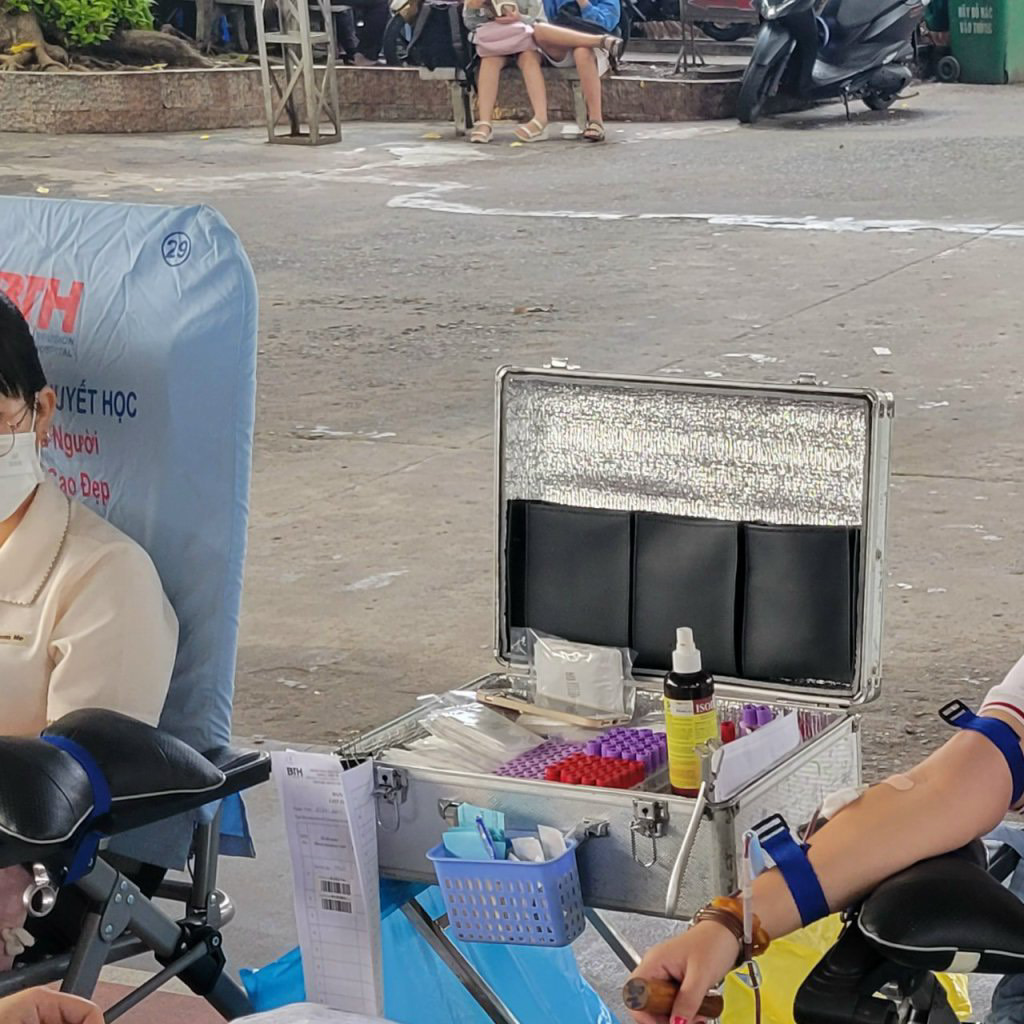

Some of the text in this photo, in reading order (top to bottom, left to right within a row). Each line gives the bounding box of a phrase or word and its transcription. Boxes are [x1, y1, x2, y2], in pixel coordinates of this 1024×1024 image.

[165, 238, 189, 259] 29
[51, 379, 138, 424] UYẾT HỌC
[52, 425, 100, 458] Người
[80, 471, 110, 506] Đẹp
